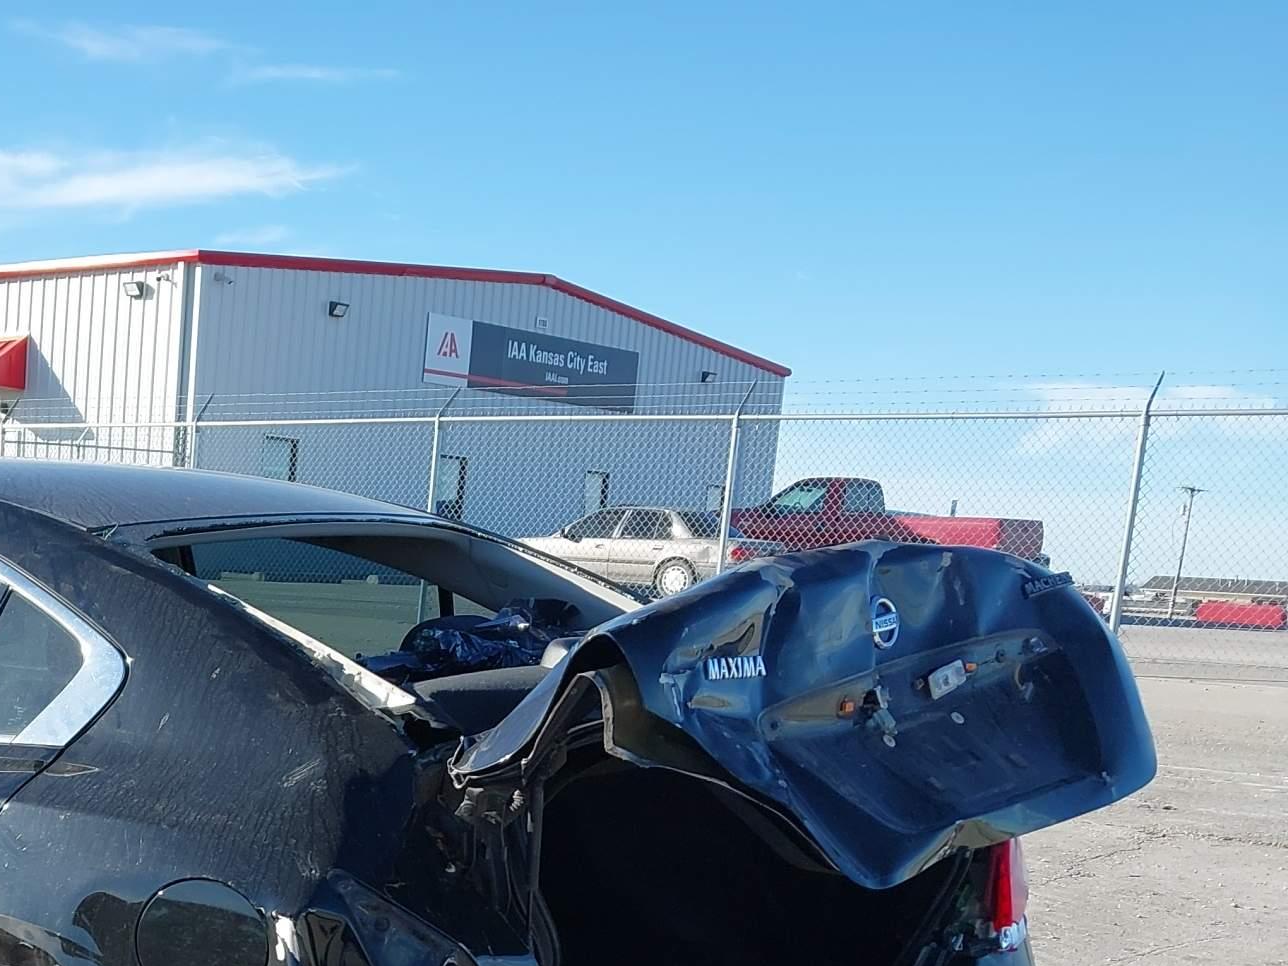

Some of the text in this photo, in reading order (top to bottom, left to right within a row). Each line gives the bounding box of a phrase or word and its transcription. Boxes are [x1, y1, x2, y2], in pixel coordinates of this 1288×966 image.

[507, 339, 609, 376] IAA Kansas City East
[708, 655, 767, 680] MAXIMA
